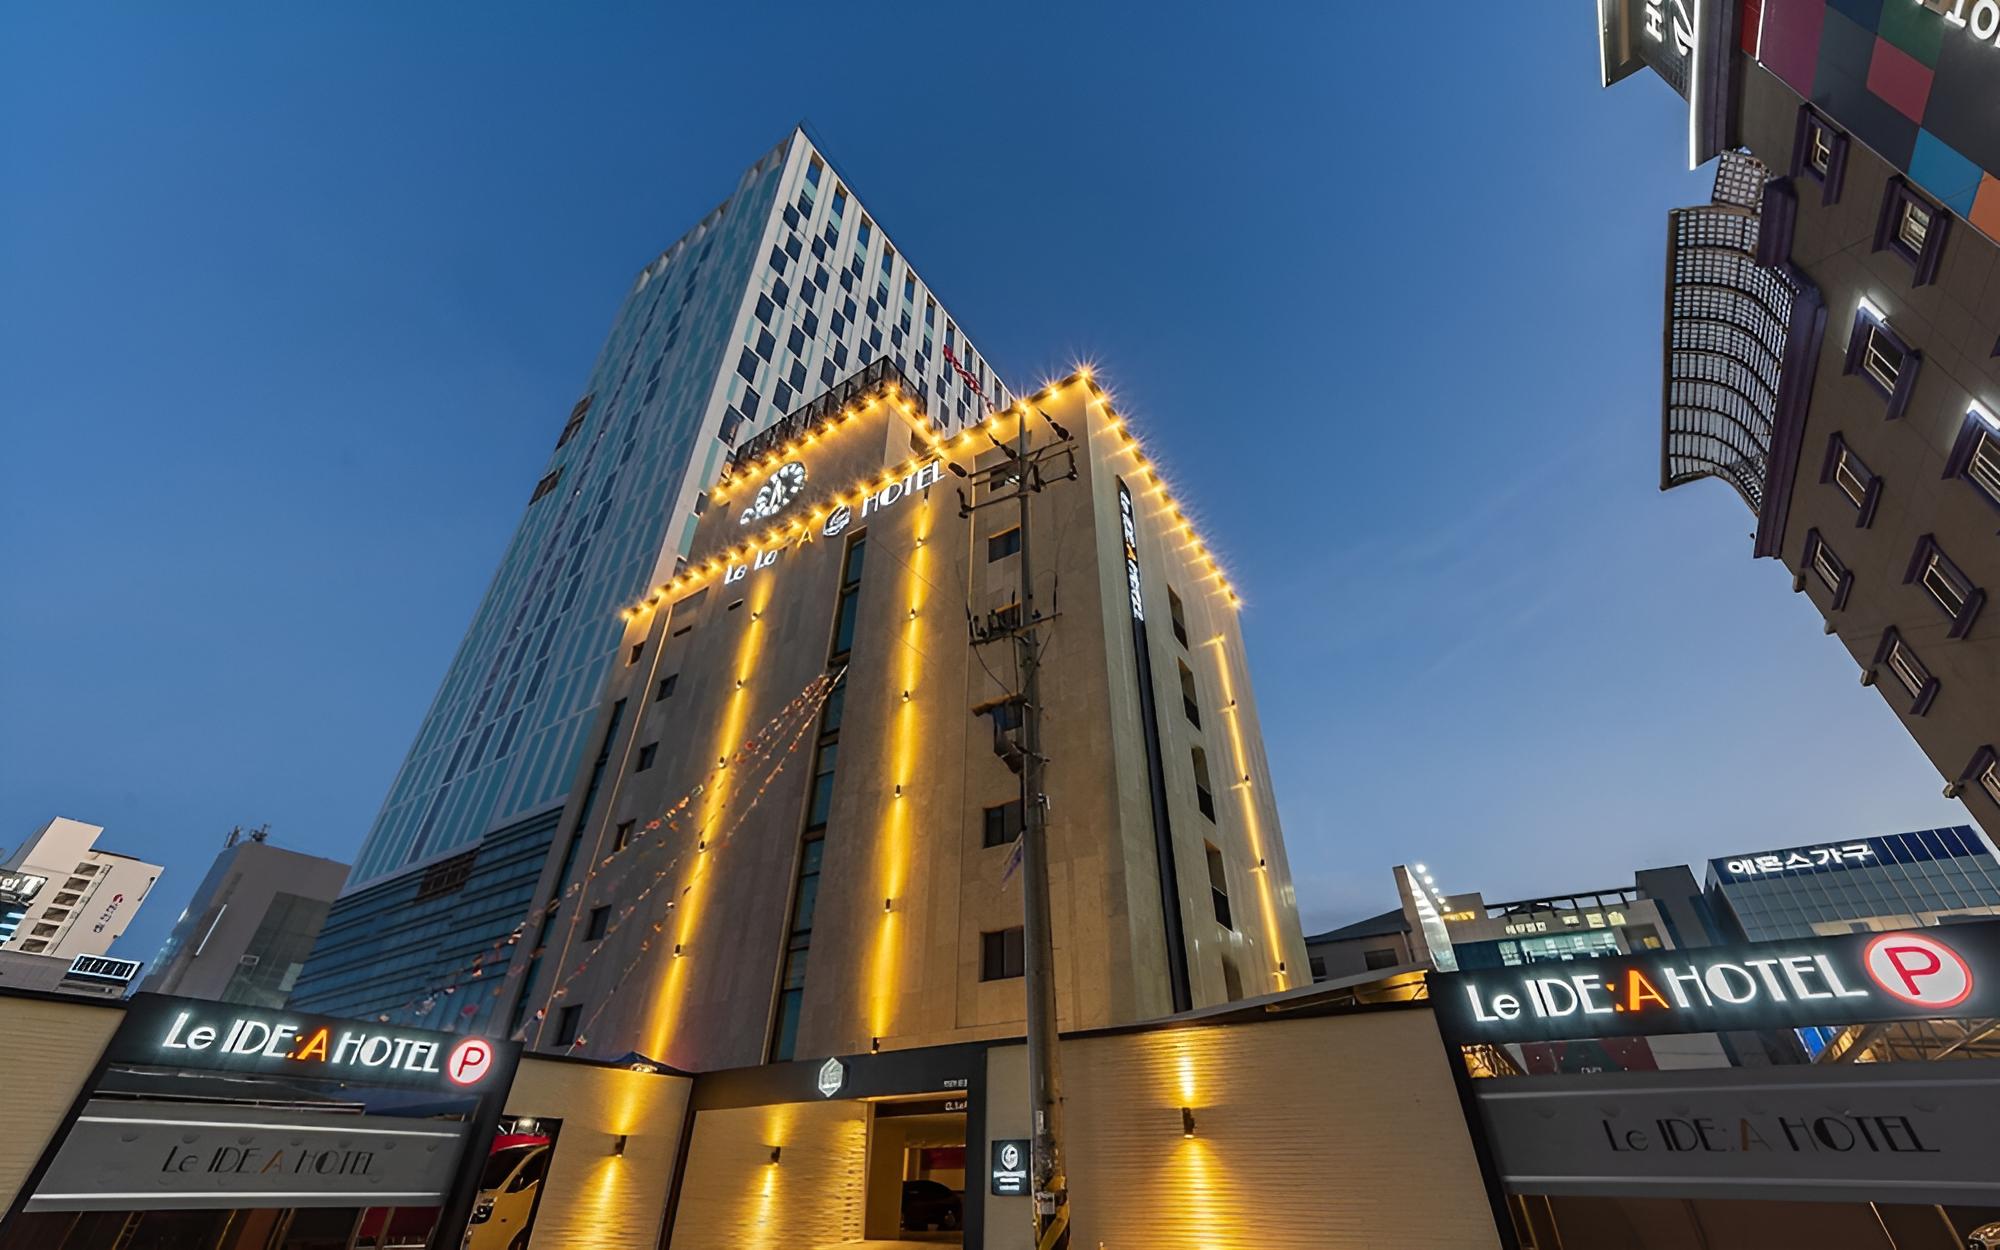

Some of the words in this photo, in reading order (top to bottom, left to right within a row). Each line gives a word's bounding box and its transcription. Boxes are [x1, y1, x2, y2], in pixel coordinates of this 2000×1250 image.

[861, 459, 946, 518] HOTEL
[1465, 983, 1521, 1022] Le
[1663, 953, 1870, 1008] HOTEL
[1884, 945, 1942, 996] P
[162, 1011, 217, 1050] Le
[331, 1031, 440, 1073] HOTEL
[457, 1046, 485, 1078] P
[161, 1145, 200, 1173] Le
[1602, 1118, 1650, 1152] Le
[1777, 1115, 1942, 1153] HOTEL
